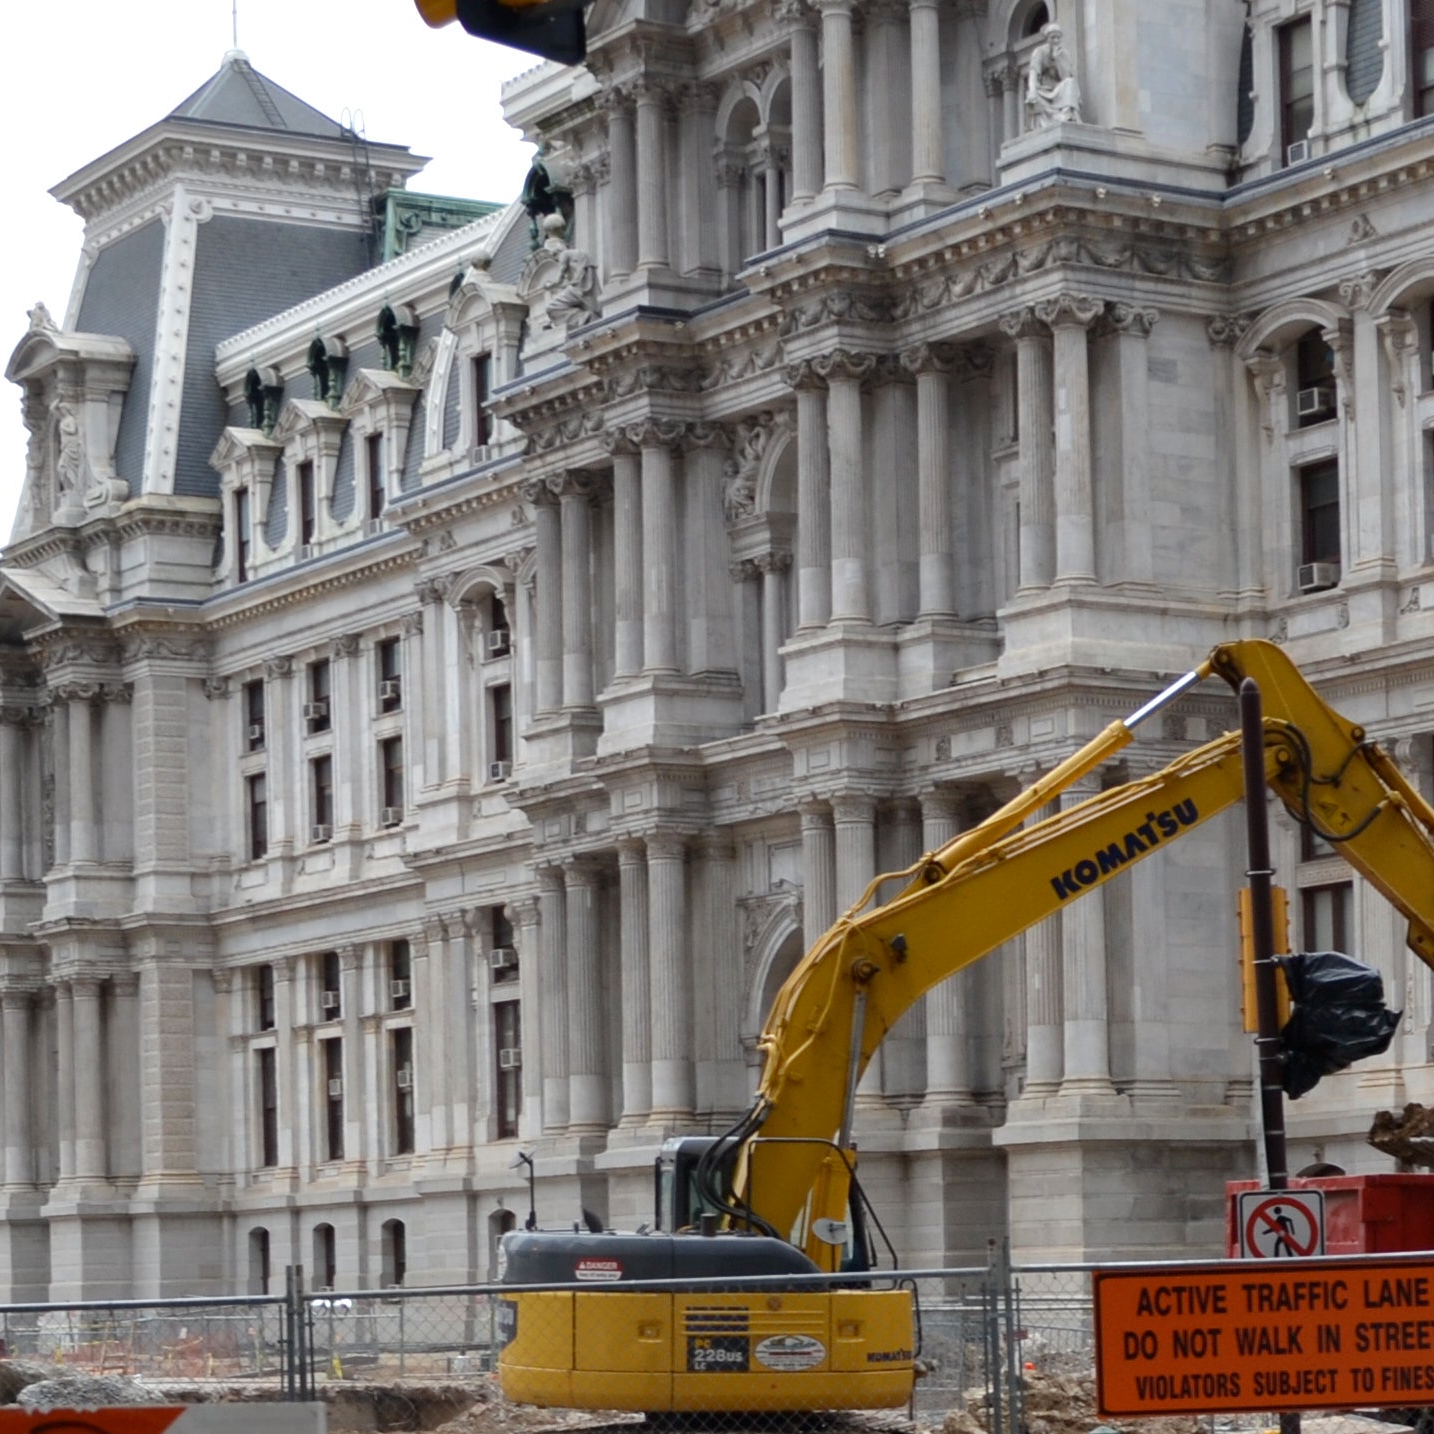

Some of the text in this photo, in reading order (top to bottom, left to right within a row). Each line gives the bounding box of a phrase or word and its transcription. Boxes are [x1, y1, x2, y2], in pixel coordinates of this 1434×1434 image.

[1050, 798, 1199, 900] KOMATSU
[587, 1261, 618, 1270] DANGER
[1137, 1277, 1430, 1317] ACTIVE TRAFFIC LANE
[694, 1338, 711, 1348] PC
[1124, 1330, 1158, 1360] DO
[1173, 1328, 1222, 1358] NOT
[1235, 1325, 1303, 1356] WALK
[1318, 1324, 1341, 1353] IN
[1136, 1366, 1434, 1400] VIOLATORS SUBJECT TO FINES
